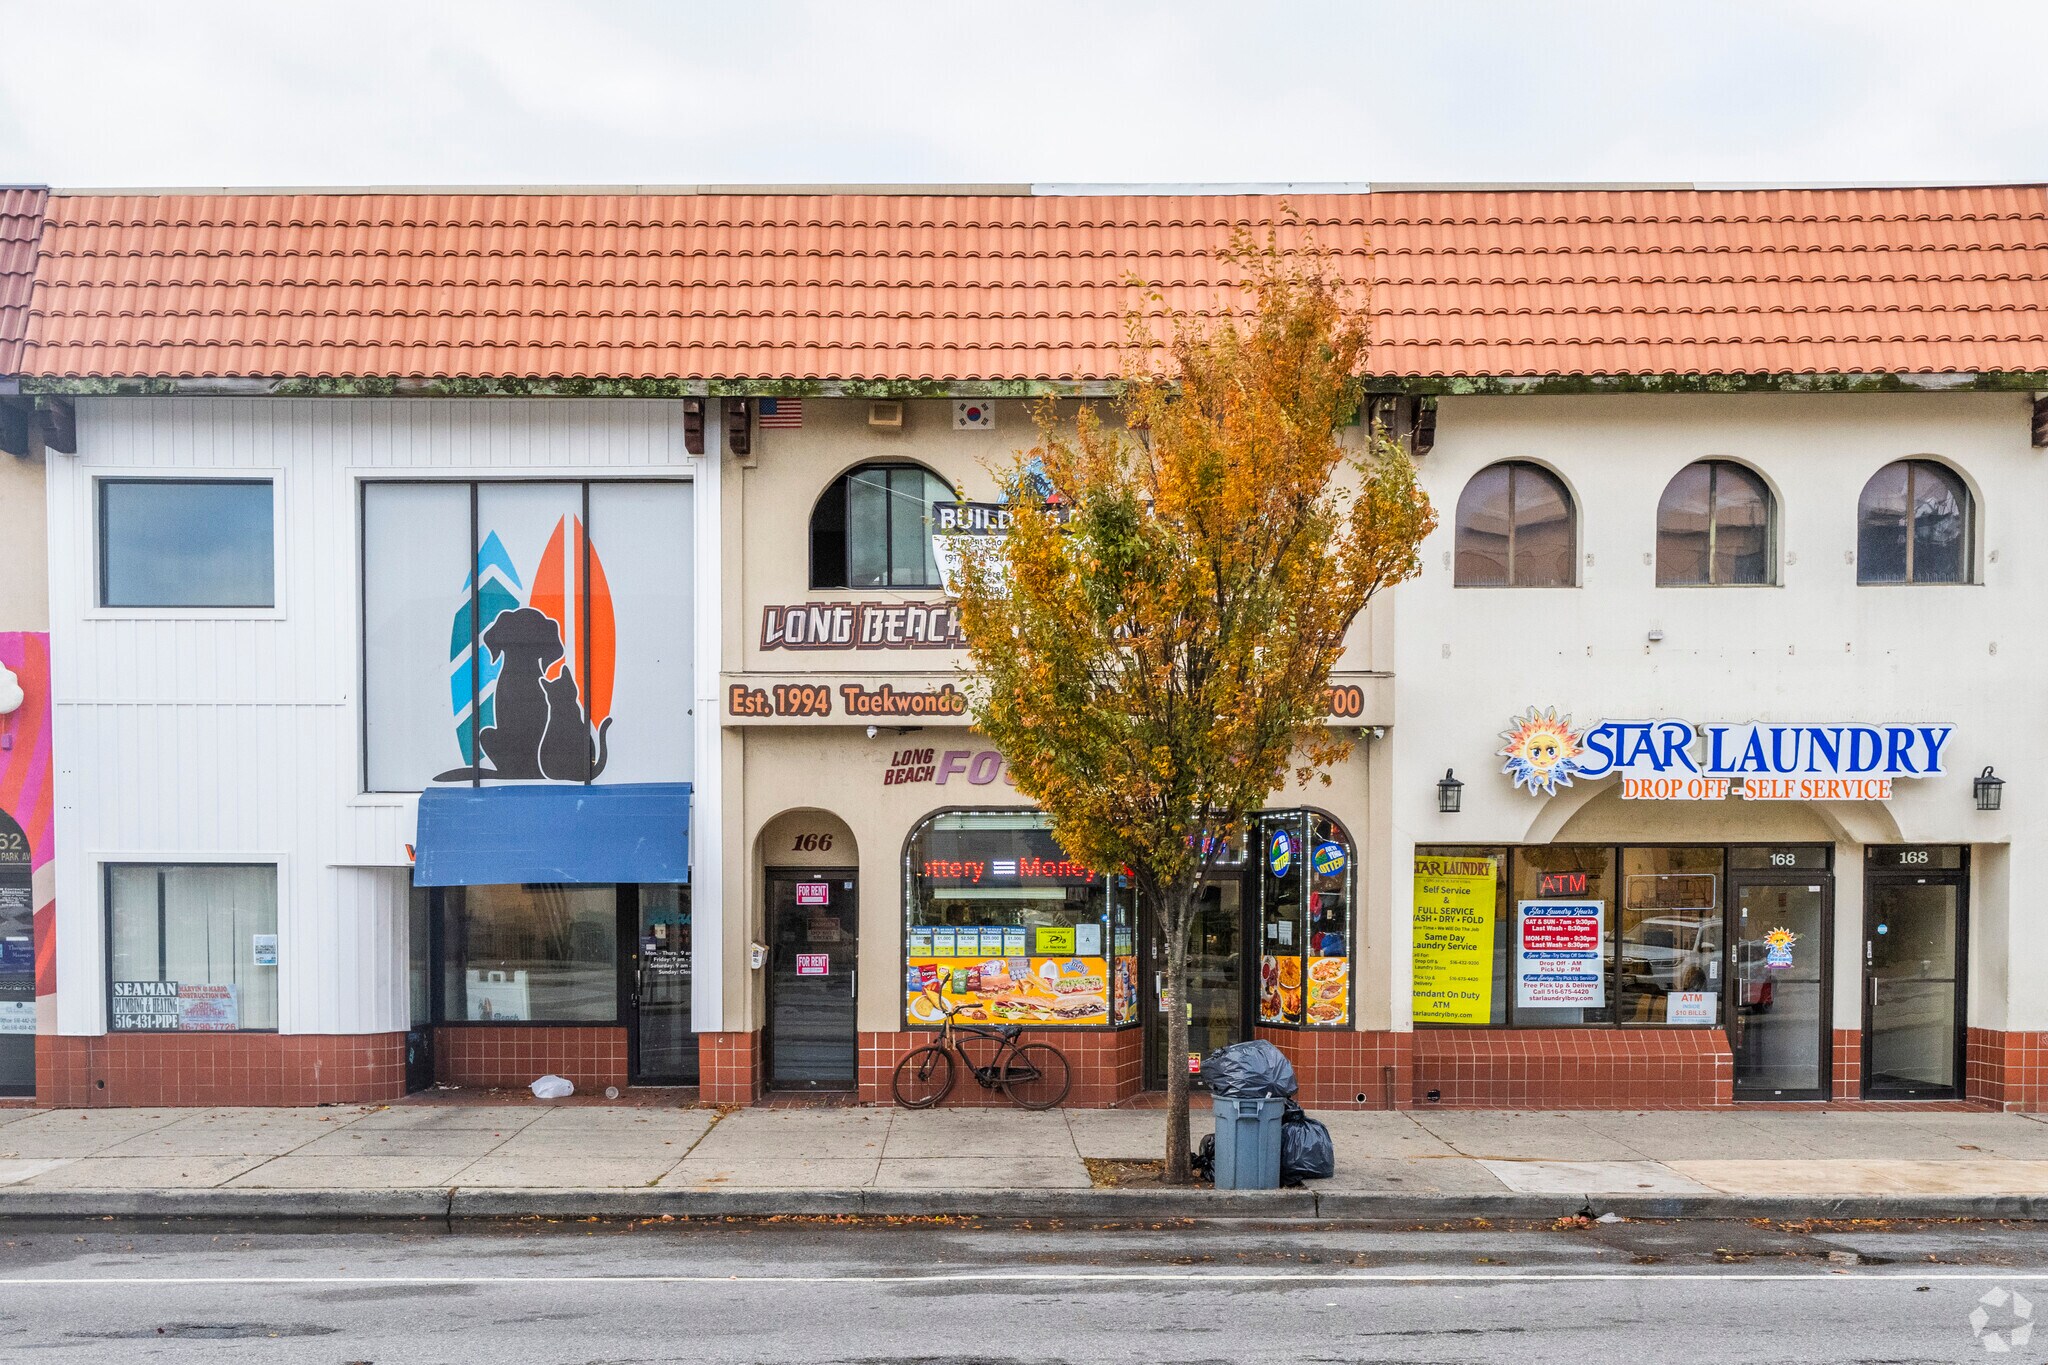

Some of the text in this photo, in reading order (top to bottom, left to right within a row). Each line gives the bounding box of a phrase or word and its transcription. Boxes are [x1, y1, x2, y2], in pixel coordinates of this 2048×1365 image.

[763, 605, 854, 645] LONG
[733, 687, 769, 713] Est.
[777, 687, 828, 713] 1994
[843, 687, 966, 713] Taekwondo
[1578, 722, 1952, 775] STAR LAUNDRY
[891, 748, 934, 767] LONG
[884, 766, 935, 785] BEACH
[1624, 779, 1682, 799] DROP
[1688, 779, 1728, 799] OFF
[1745, 779, 1796, 799] SELF
[1801, 779, 1891, 799] SERVICE
[792, 833, 833, 852] 166
[1, 852, 19, 861] PARK
[1770, 853, 1796, 866] 168
[1899, 851, 1929, 864] 168
[1316, 857, 1345, 874] LOTTERY
[1443, 861, 1491, 877] LAUNDRY
[1540, 873, 1587, 894] ATM
[798, 886, 827, 896] FOR RENT
[1424, 886, 1471, 895] Self Service
[1443, 896, 1450, 904] &
[1418, 907, 1475, 916] FULL SERVICE
[1528, 907, 1594, 916] Star Laundry Hours
[1413, 915, 1484, 924] ASH DRY FOLD
[1424, 933, 1465, 943] Same Day
[1448, 942, 1478, 951] Service
[798, 957, 827, 967] FOR RENT
[114, 982, 177, 996] SEAMAN
[1447, 990, 1459, 1000] On
[1460, 990, 1481, 1000] Duty
[1681, 994, 1703, 1002] ATM
[114, 998, 178, 1013] PLUMBING & HEATING
[1433, 1001, 1450, 1009] ATM
[115, 1014, 178, 1029] 516-431-PIPE
[180, 1023, 236, 1031] 16-790-7726
